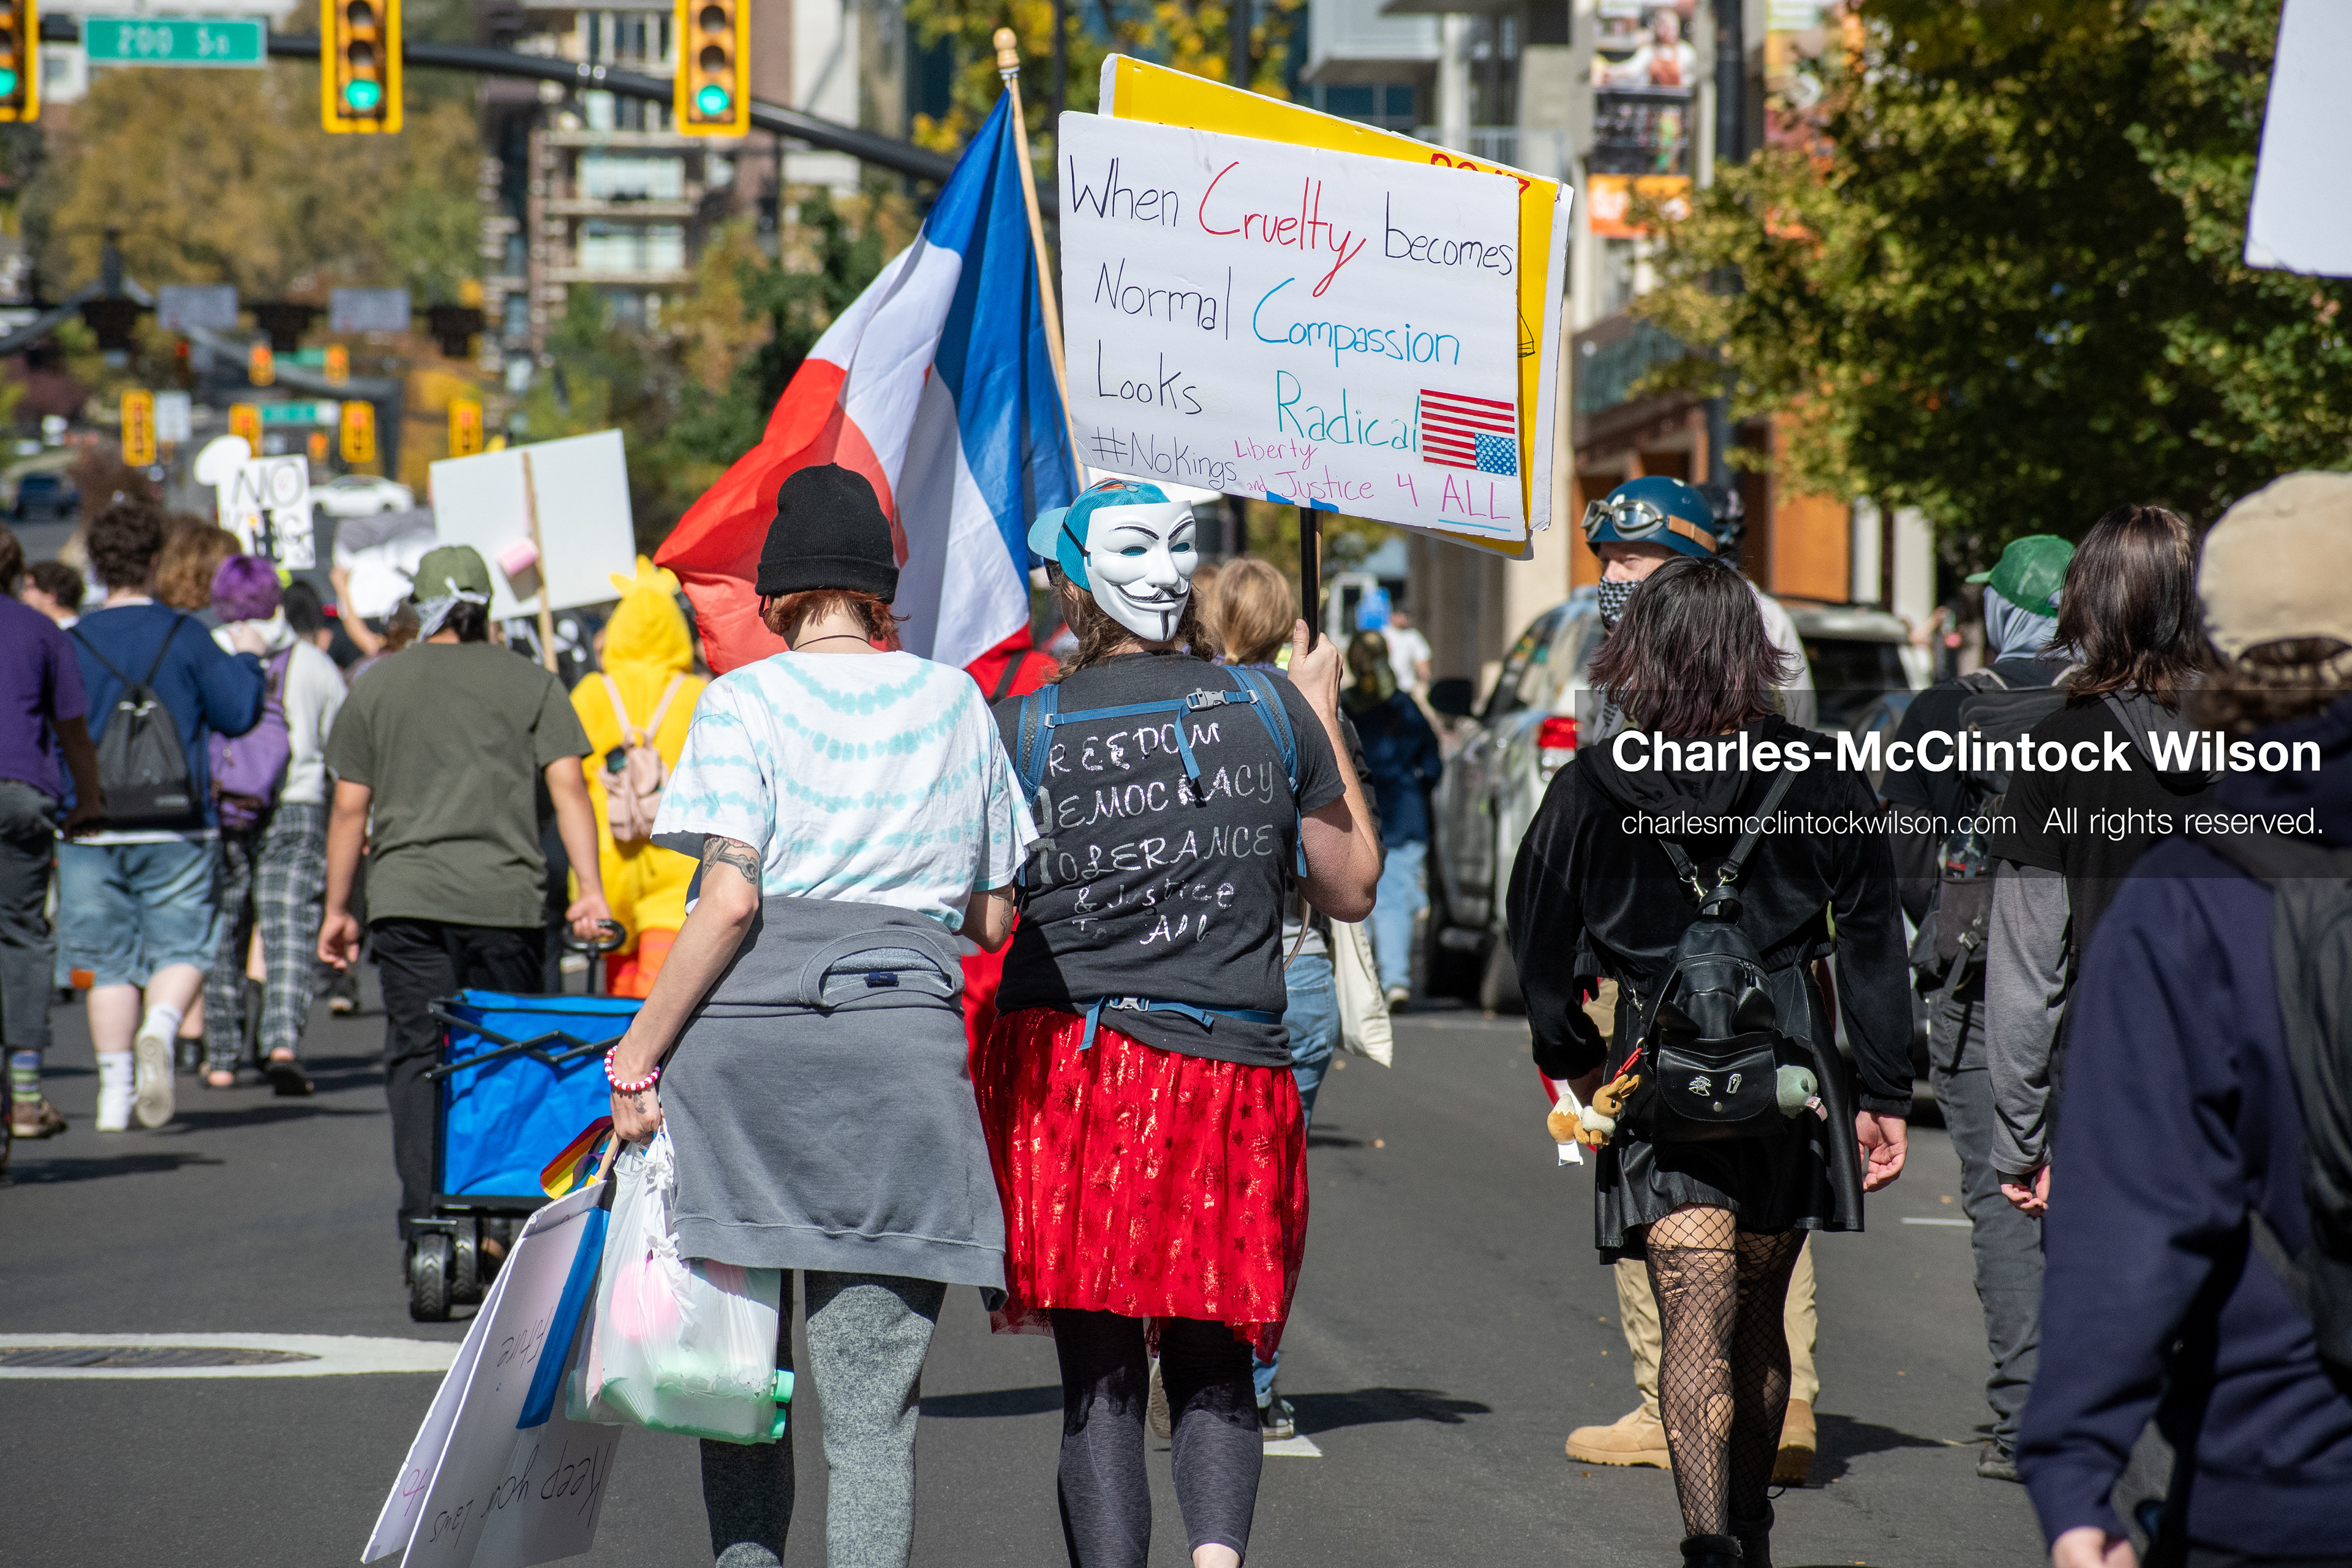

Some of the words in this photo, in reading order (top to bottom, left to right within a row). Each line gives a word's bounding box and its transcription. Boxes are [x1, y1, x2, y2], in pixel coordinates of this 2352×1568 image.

[117, 25, 173, 57] 200
[1070, 155, 1178, 227] When
[1199, 161, 1366, 298] Cruelty
[1386, 192, 1513, 276] becomes
[1095, 258, 1232, 341] Normal
[1253, 277, 1460, 368] Compassion
[1098, 339, 1202, 415] Looks
[1276, 370, 1421, 453] Radical
[232, 461, 303, 508] NO
[1090, 426, 1238, 490] #NoKings
[1234, 436, 1319, 470] Liberty
[1246, 474, 1268, 492] and
[1275, 464, 1374, 500] Justice
[1396, 473, 1419, 507] 4
[1441, 473, 1511, 520] ALL
[1049, 722, 1221, 777] REEDOM
[1029, 824, 1273, 885] TOLERANCE
[1074, 884, 1098, 914] &
[402, 1468, 429, 1517] to
[541, 1439, 611, 1528] Keep
[429, 1499, 474, 1550] Laws
